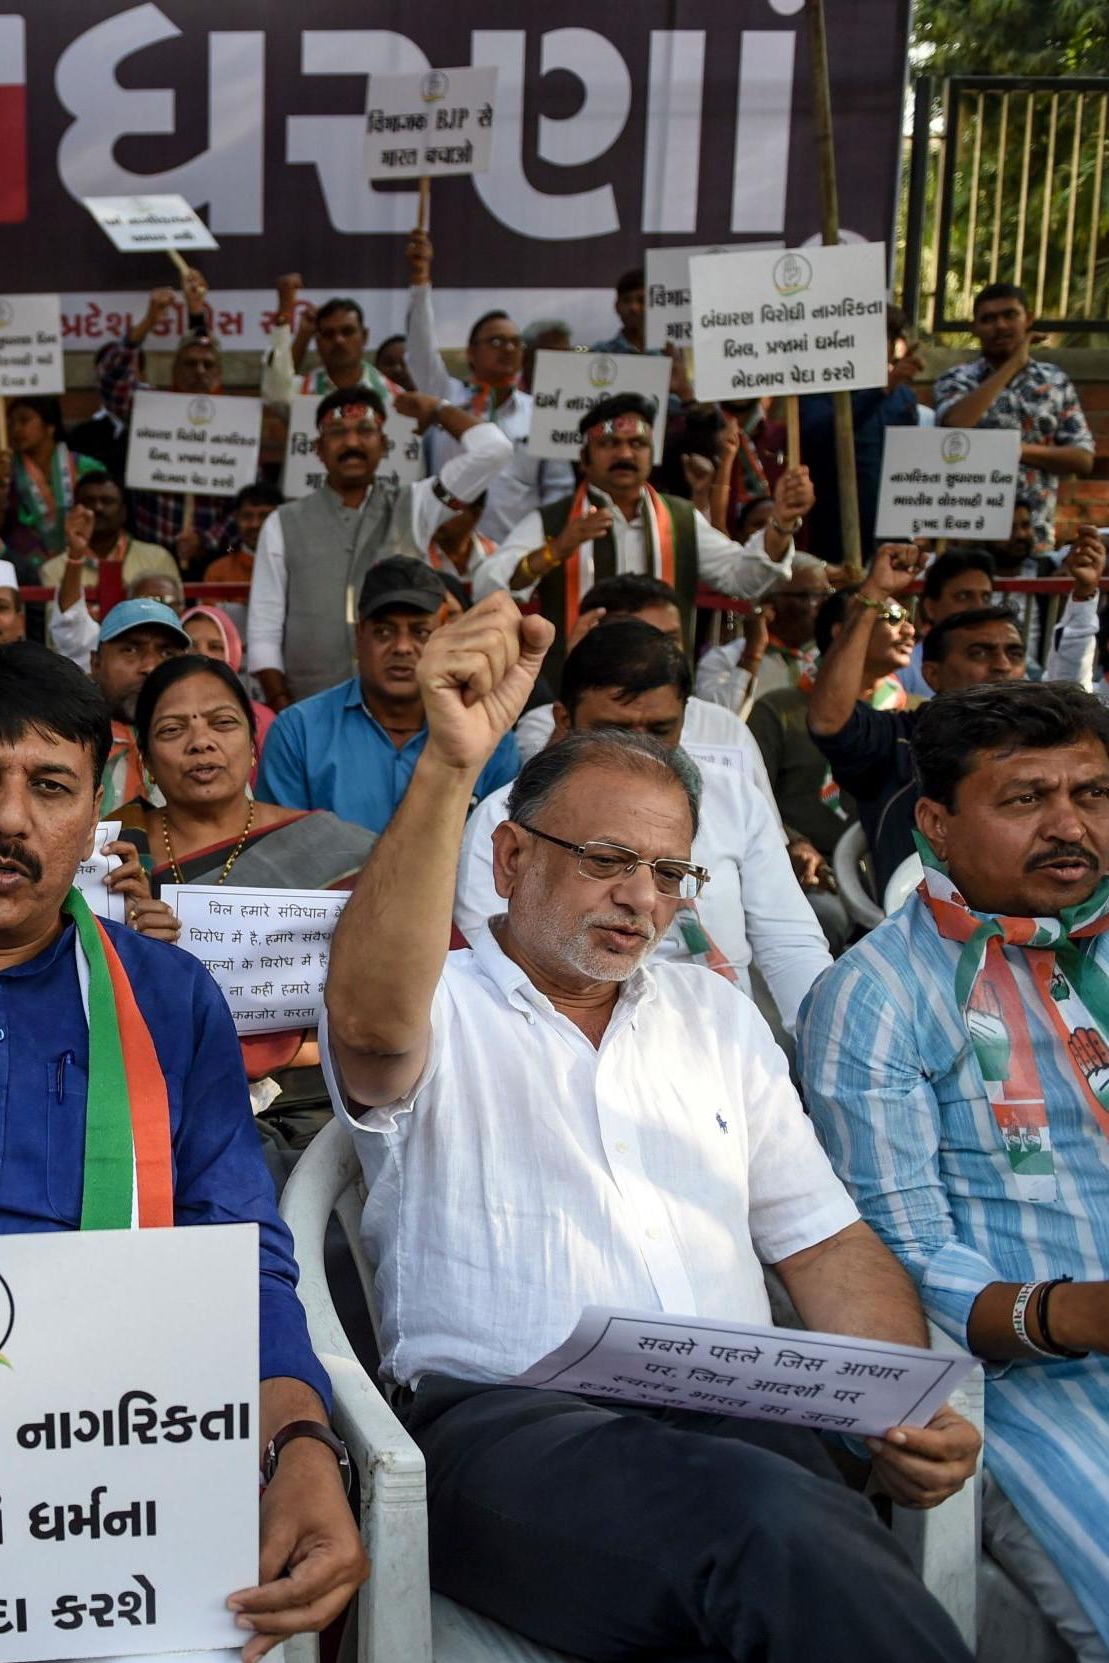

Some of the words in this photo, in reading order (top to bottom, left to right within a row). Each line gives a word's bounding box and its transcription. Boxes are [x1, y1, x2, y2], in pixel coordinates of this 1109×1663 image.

[55, 0, 806, 240] ધરણાં
[436, 107, 470, 130] BJP
[701, 310, 754, 328] બંધારણ
[760, 302, 805, 323] વિરોધી
[811, 297, 883, 319] નાગરિકતા
[240, 903, 271, 919] हमारे
[278, 903, 327, 919] संविधान
[189, 927, 225, 944] विरोध
[232, 929, 243, 944] में
[265, 931, 294, 945] हमारे
[241, 959, 254, 972] के
[260, 955, 295, 970] विरोध
[301, 953, 312, 967] में
[229, 986, 243, 996] ना
[250, 980, 274, 996] कहीं
[281, 981, 311, 995] हमारे
[283, 1007, 315, 1019] करता
[638, 1336, 698, 1356] सबसे
[710, 1345, 765, 1364] पहले
[774, 1350, 828, 1372] जिस
[835, 1361, 909, 1381] आधार
[688, 1367, 739, 1386] जिन
[833, 1389, 865, 1404] पर
[16, 1390, 250, 1450] નાગરિકતા
[689, 1391, 750, 1408] भारत
[760, 1403, 790, 1416] का
[801, 1411, 860, 1428] जन्म
[28, 1485, 157, 1541] ધર્મના
[51, 1574, 157, 1630] કરશે
